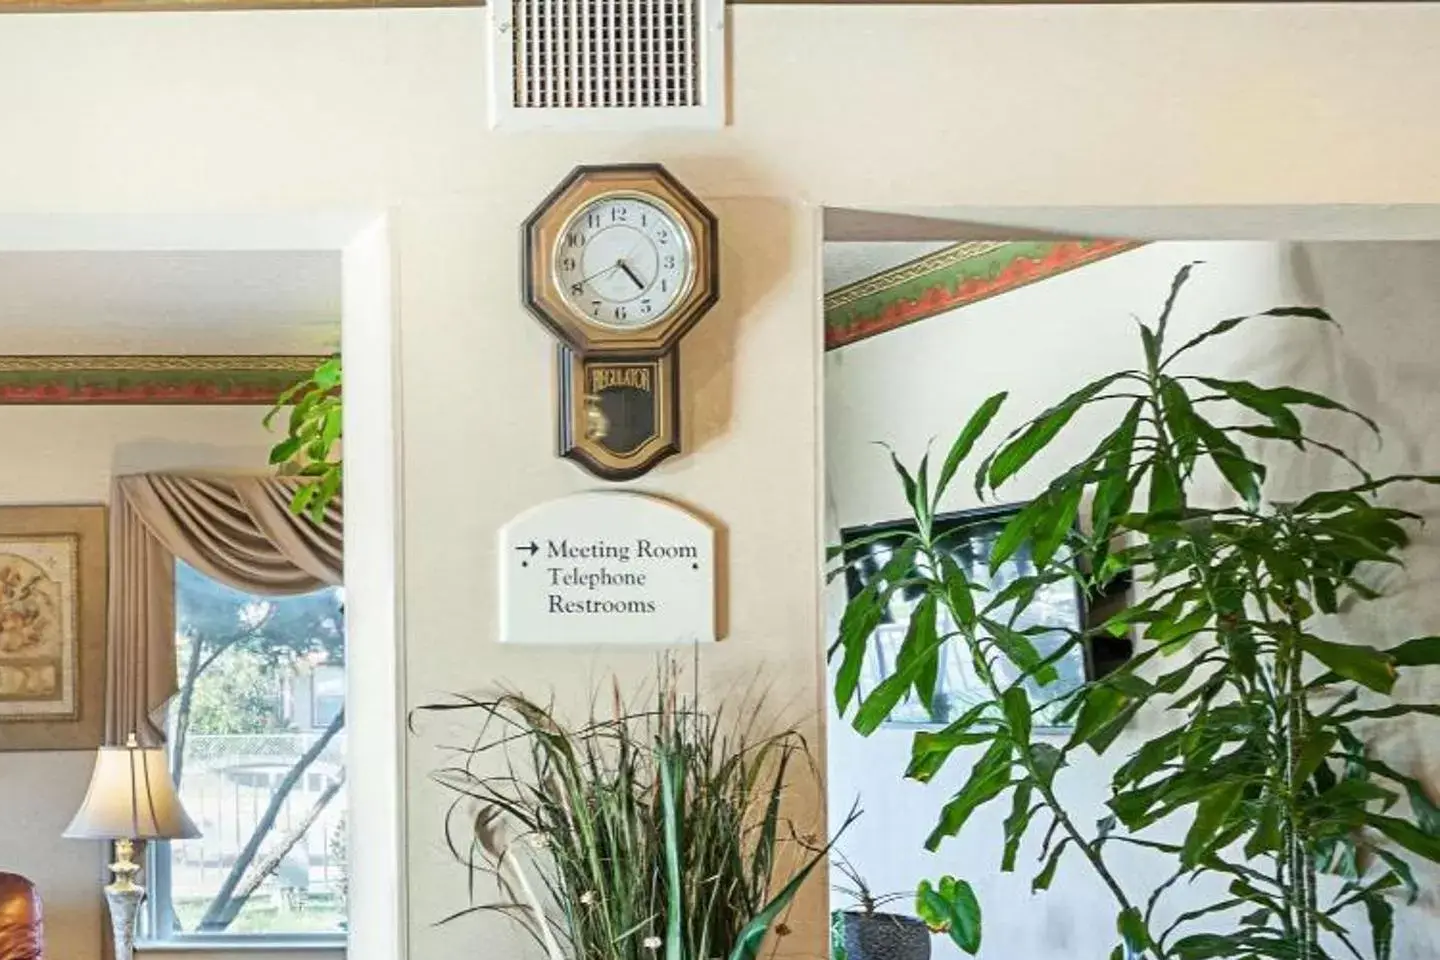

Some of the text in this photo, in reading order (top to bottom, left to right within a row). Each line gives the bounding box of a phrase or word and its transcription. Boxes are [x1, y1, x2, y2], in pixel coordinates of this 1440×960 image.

[588, 214, 601, 228] 11
[611, 207, 627, 222] 12
[641, 214, 647, 228] 1
[566, 232, 586, 248] 10
[657, 230, 668, 245] 2
[563, 258, 576, 272] 9
[663, 255, 675, 270] 3
[571, 282, 584, 296] 8
[591, 300, 602, 316] 7
[614, 306, 627, 320] 6
[640, 299, 652, 313] 5
[546, 539, 698, 562] Meeting Room
[547, 567, 647, 589] Telephone
[548, 595, 656, 614] Restrooms
